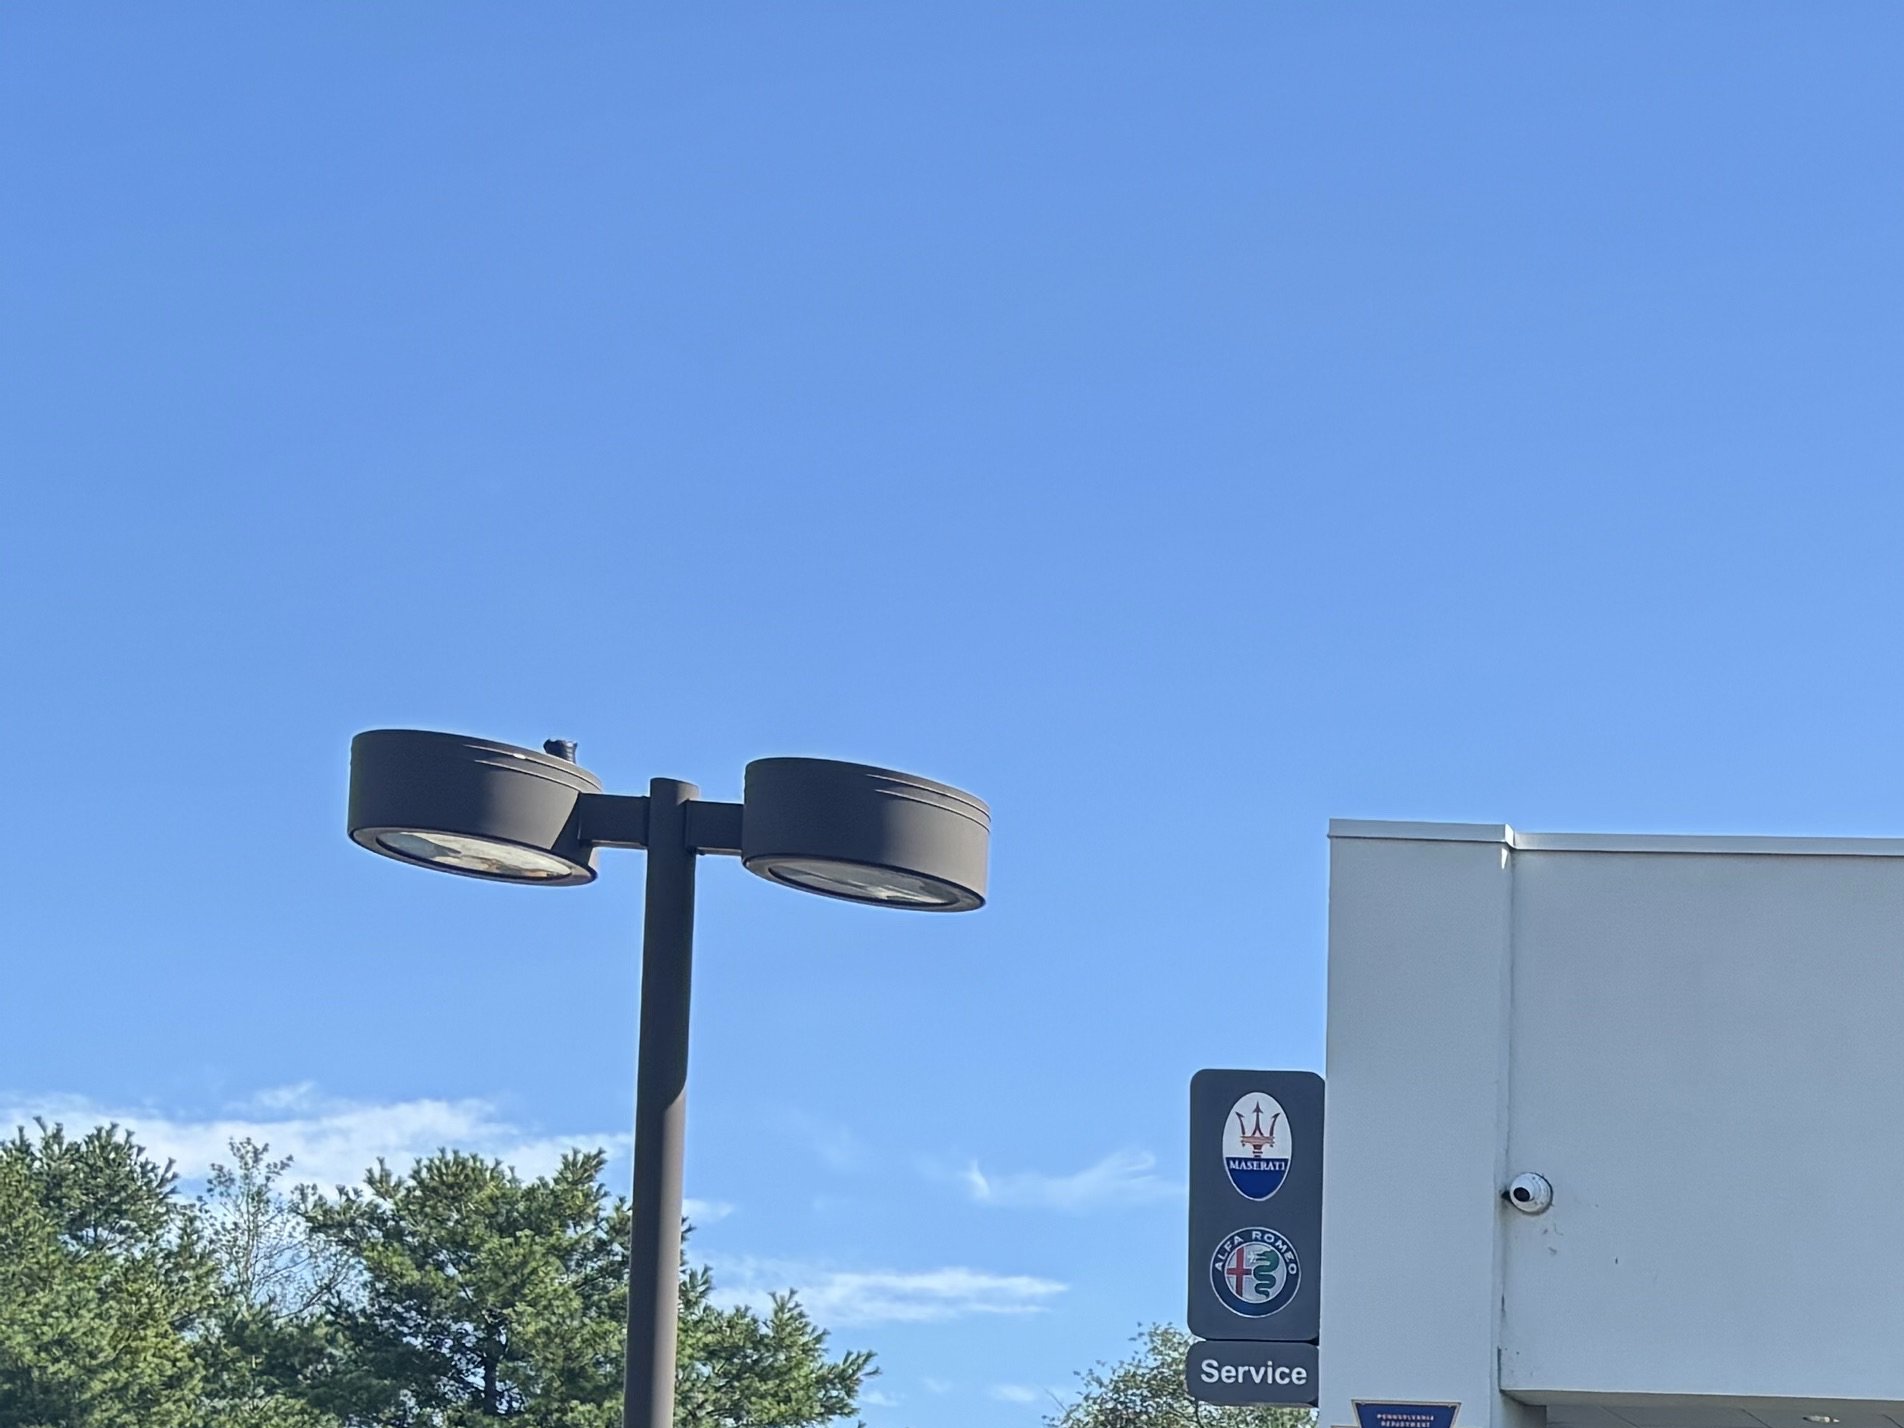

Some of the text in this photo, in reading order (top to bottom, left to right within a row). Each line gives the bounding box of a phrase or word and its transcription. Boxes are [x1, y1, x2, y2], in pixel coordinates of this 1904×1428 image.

[1229, 1160, 1286, 1171] MASERATI
[1214, 1231, 1297, 1275] ALFA ROMEO
[1200, 1359, 1307, 1384] Service
